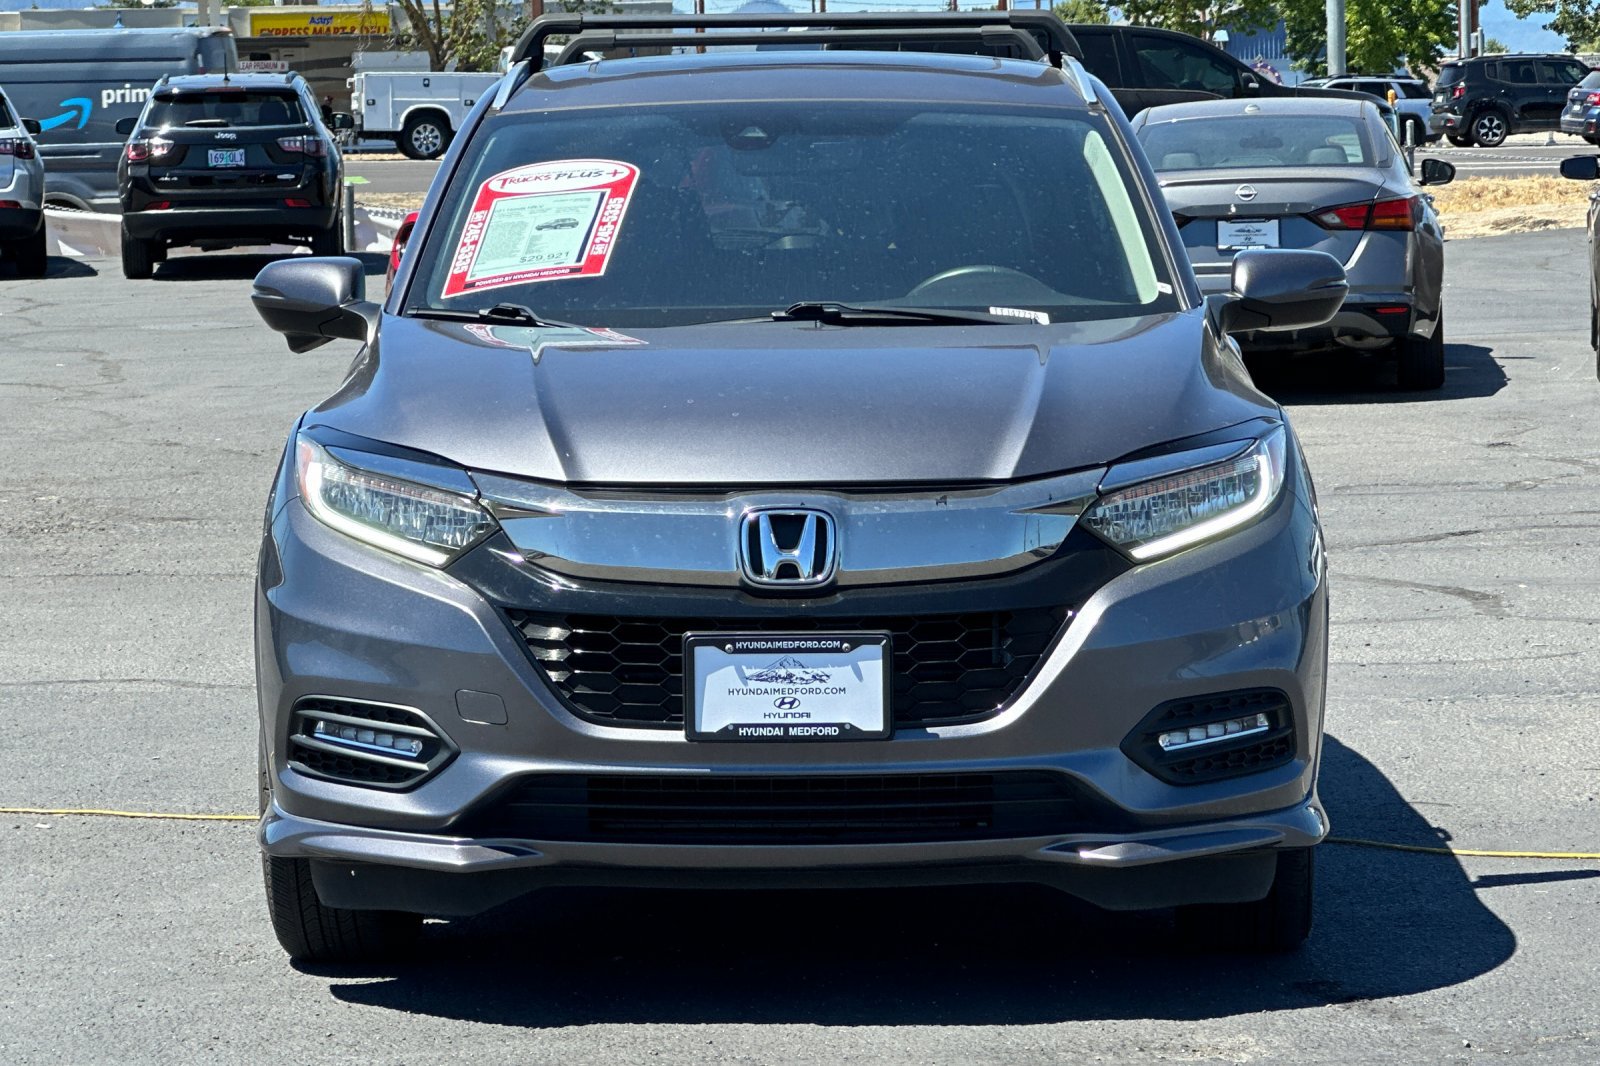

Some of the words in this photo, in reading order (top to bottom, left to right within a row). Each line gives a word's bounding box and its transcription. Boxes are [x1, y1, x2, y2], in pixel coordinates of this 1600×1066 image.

[214, 131, 237, 140] Jeep
[596, 197, 625, 244] 245-5335
[454, 221, 484, 274] 245-5335
[475, 277, 504, 286] POWERED
[512, 272, 540, 282] HYUNDAI
[540, 268, 570, 277] MEDFORD
[735, 640, 841, 650] HYUNDAIMEDFORD.COM
[727, 687, 847, 696] HYUNDAIMEDFORD.COM
[763, 711, 811, 719] HYUNDAI
[738, 726, 784, 736] HYUNDAI
[788, 726, 840, 736] MEDFORD
